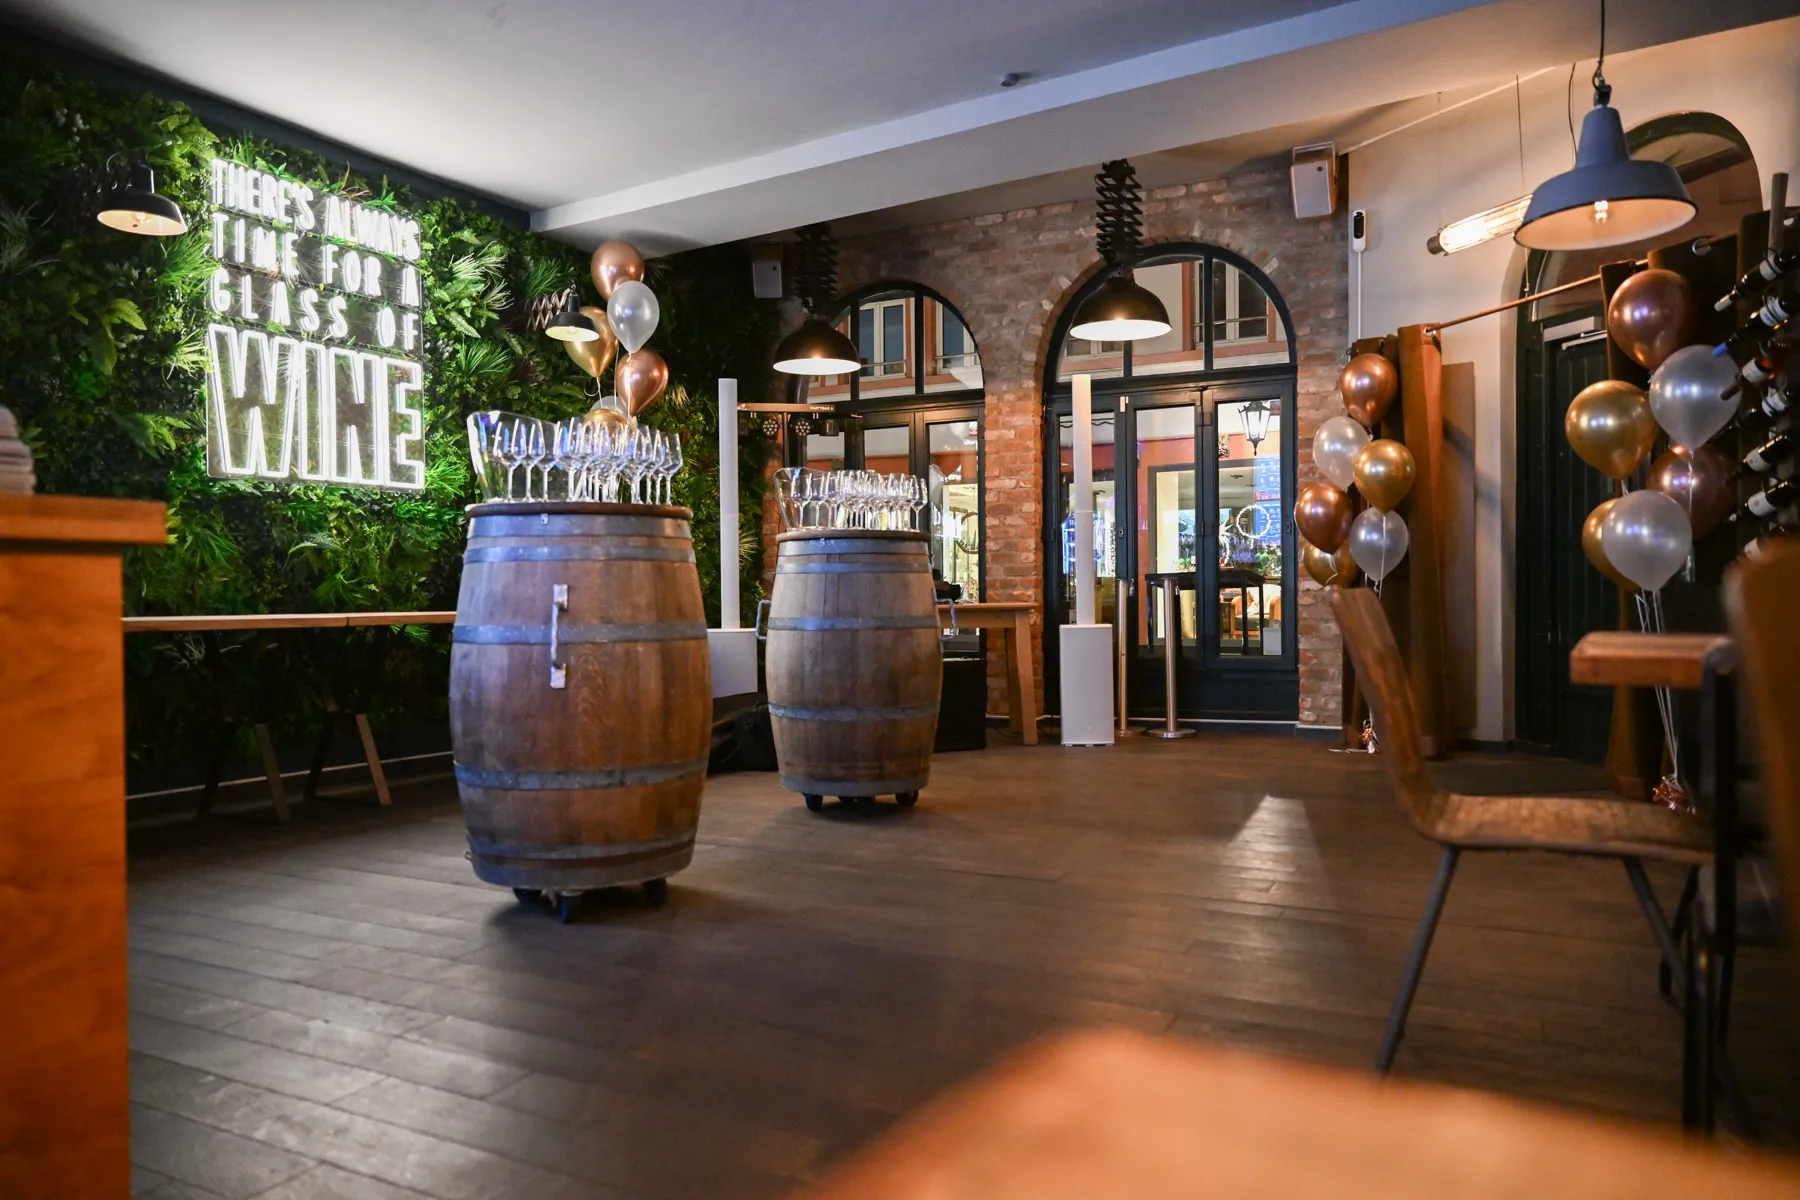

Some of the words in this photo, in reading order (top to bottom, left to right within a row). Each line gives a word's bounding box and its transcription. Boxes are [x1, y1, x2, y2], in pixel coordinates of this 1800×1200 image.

[212, 158, 314, 230] THERE'S
[324, 195, 420, 260] ALWAYS
[210, 267, 347, 338] GLASS
[376, 307, 419, 350] OF
[212, 212, 300, 276] TIME
[322, 244, 382, 296] FOR
[402, 266, 420, 307] A
[208, 323, 425, 489] WINE
